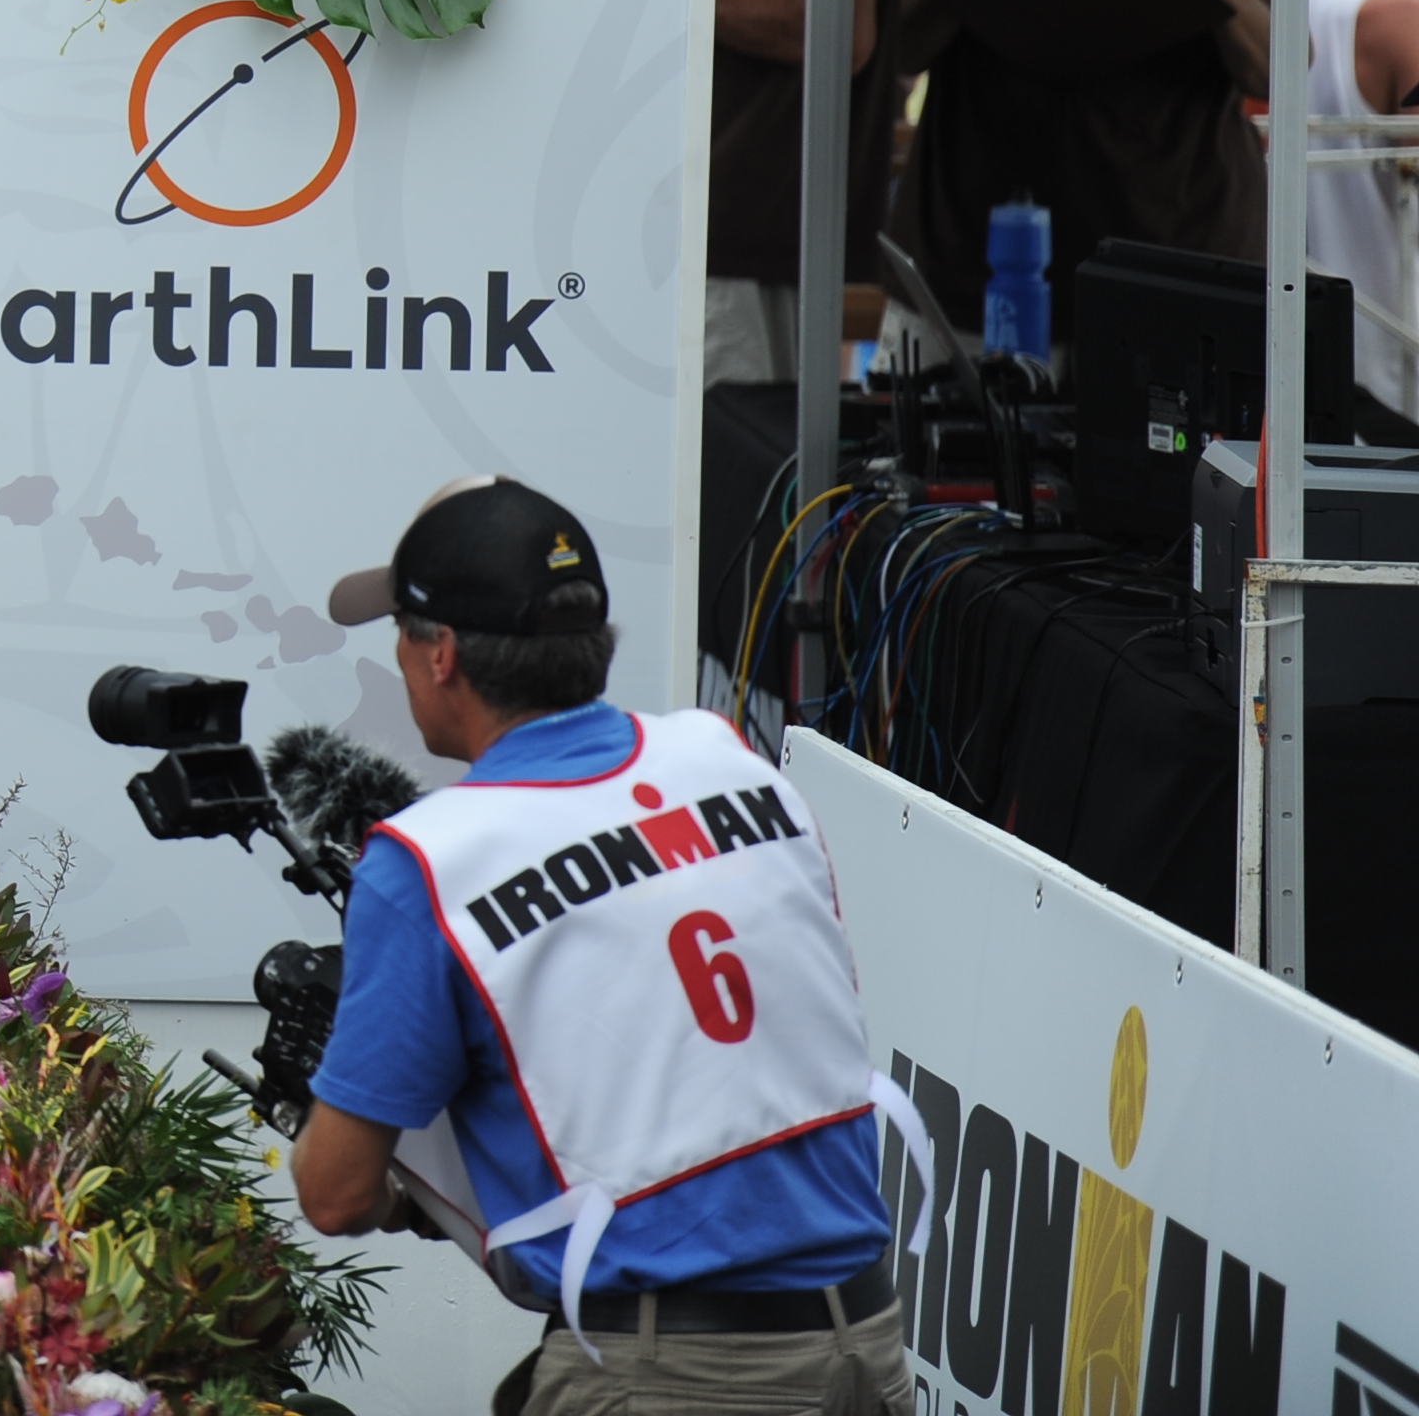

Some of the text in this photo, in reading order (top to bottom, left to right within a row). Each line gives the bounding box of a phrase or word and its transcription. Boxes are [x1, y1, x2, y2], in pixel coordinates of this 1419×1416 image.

[465, 782, 802, 953] IRONMAN
[668, 909, 755, 1045] 6
[877, 1005, 1287, 1416] IRONMAN
